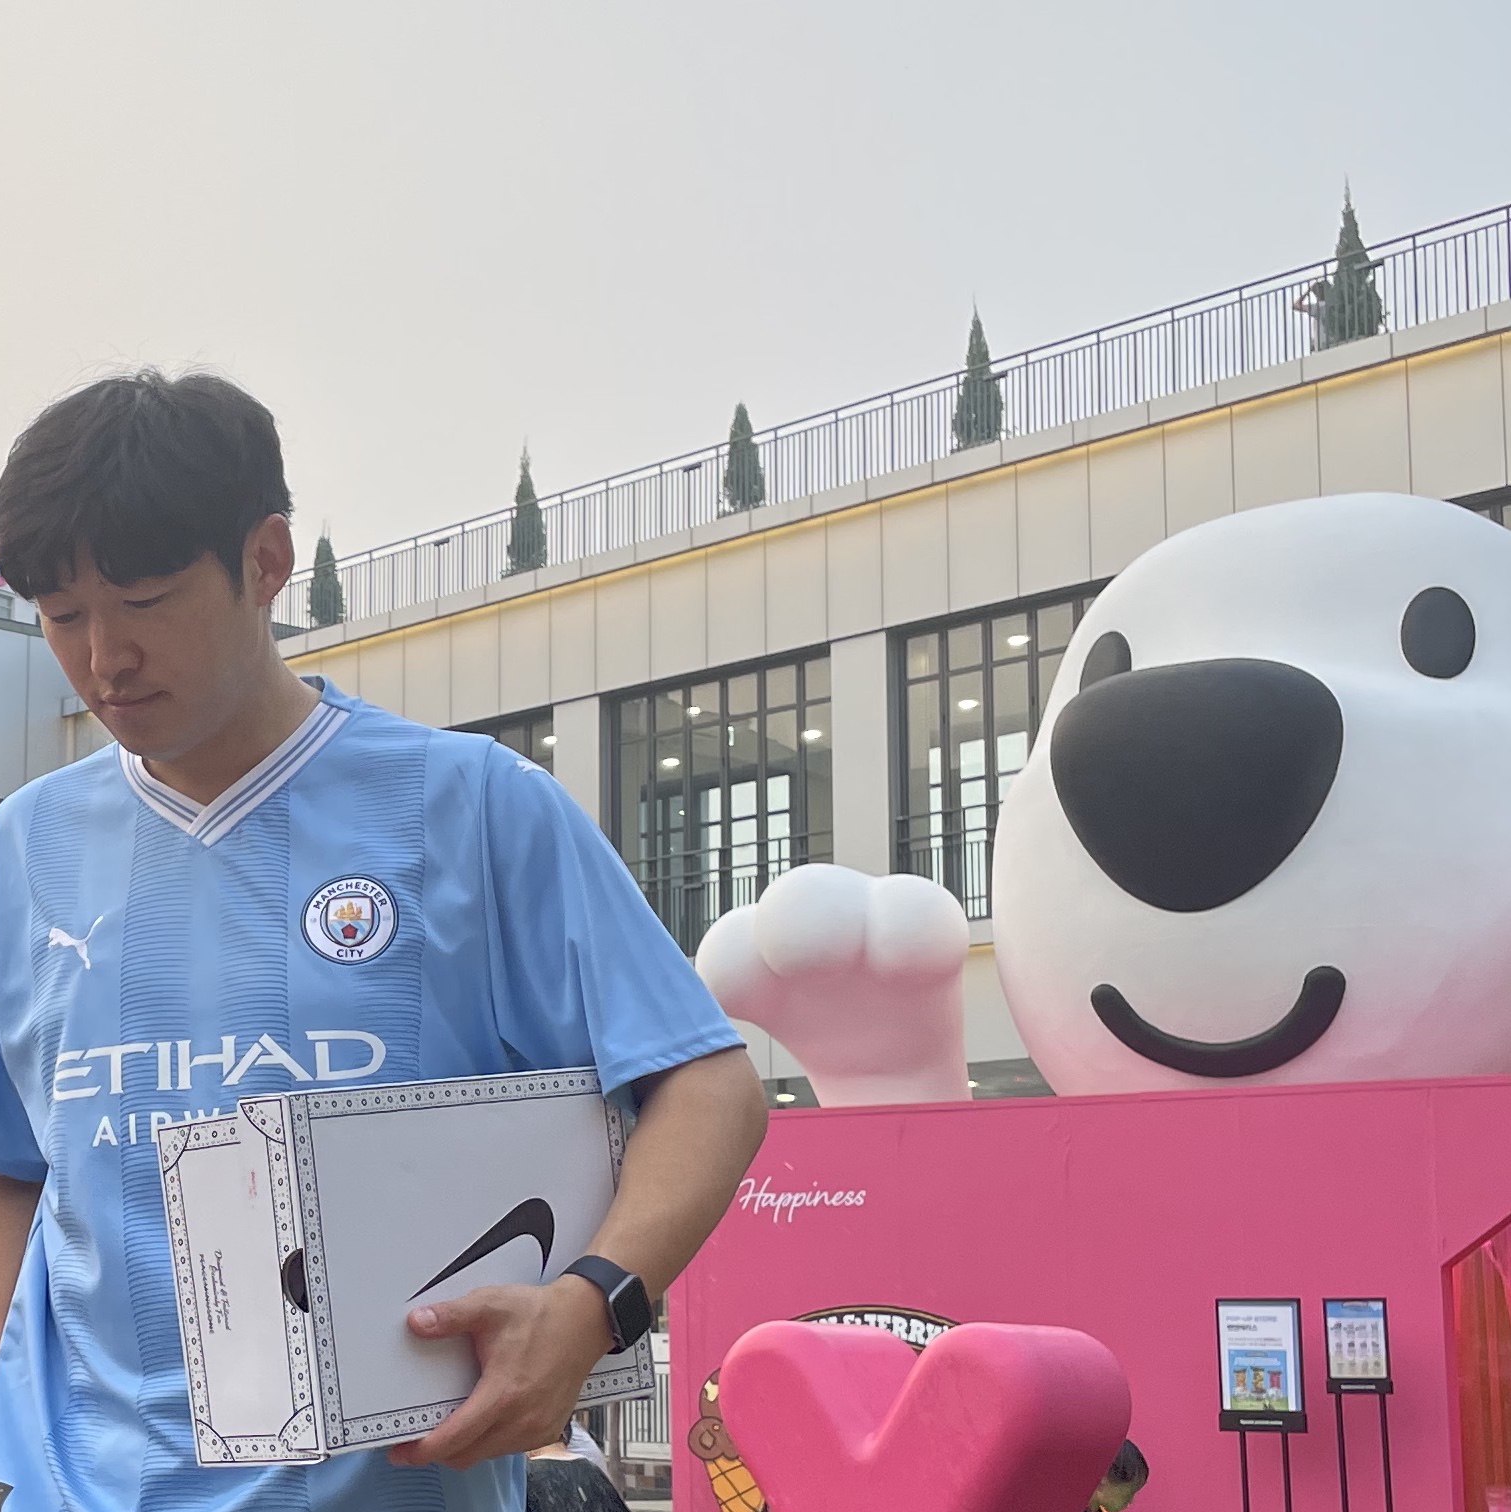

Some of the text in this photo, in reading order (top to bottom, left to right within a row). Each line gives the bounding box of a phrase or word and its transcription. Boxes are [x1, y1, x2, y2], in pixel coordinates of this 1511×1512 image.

[313, 881, 388, 910] MANCHESTER
[336, 948, 364, 958] CITY
[52, 1030, 387, 1101] ETIHAD
[738, 1176, 867, 1223] Happiness
